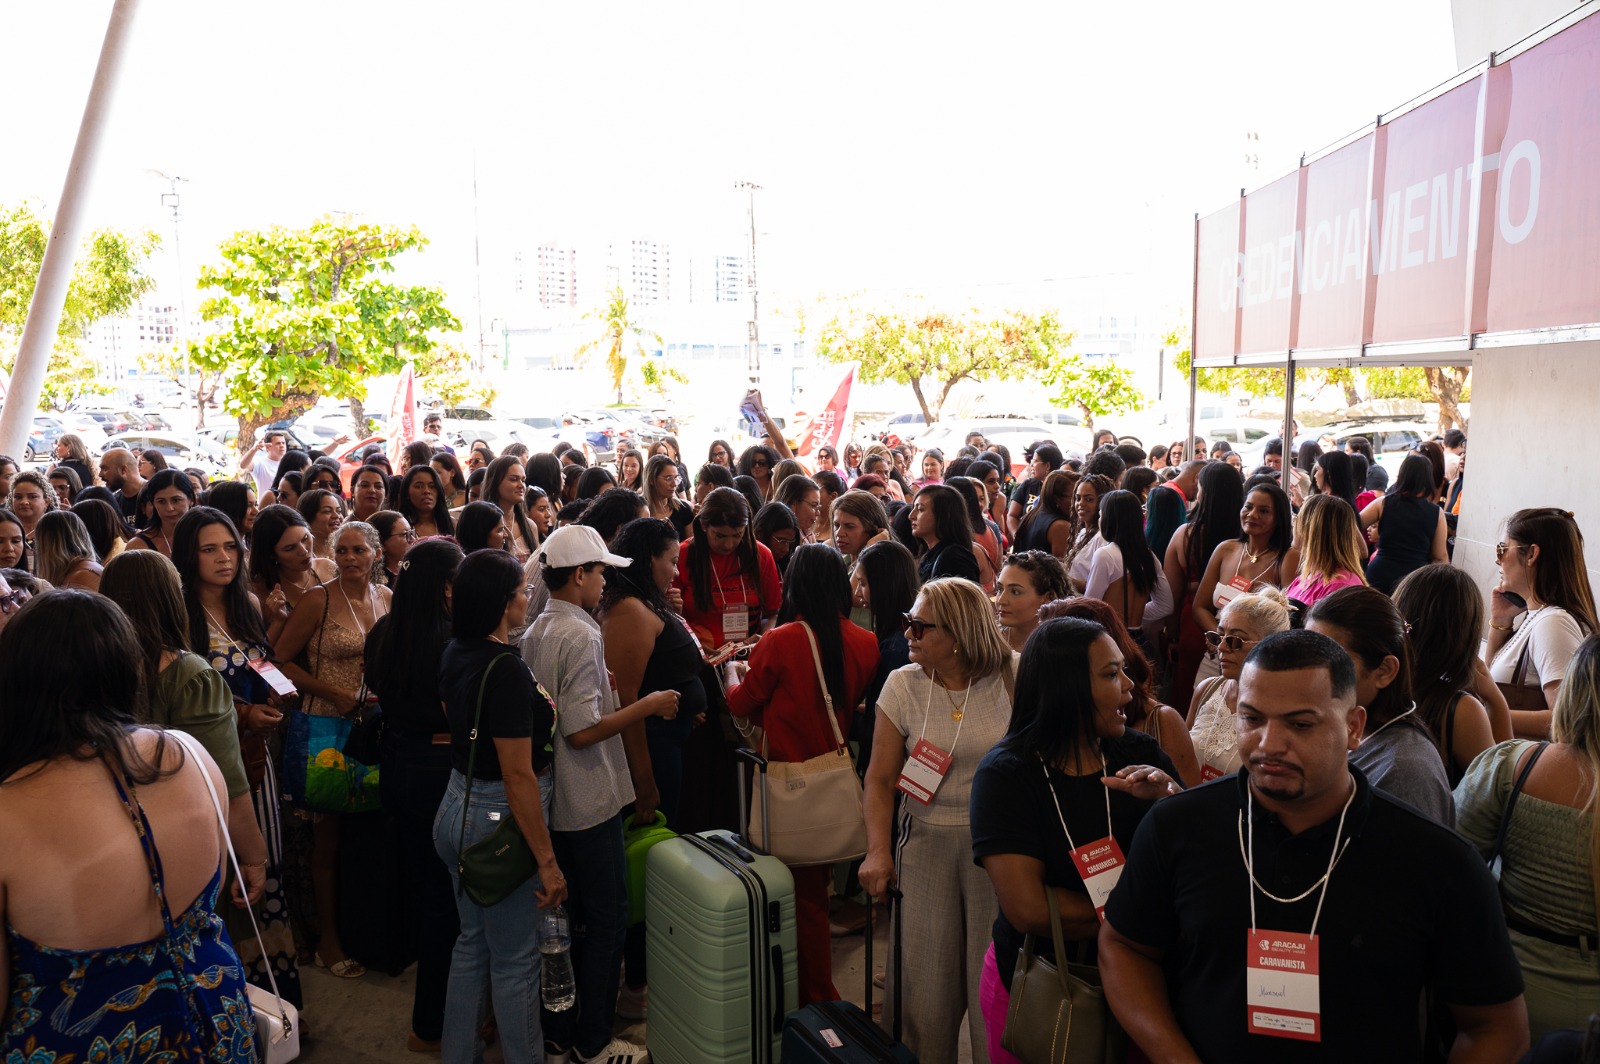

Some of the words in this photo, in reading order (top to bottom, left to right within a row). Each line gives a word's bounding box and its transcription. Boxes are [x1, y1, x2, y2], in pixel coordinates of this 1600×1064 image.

[1218, 139, 1542, 313] CREDENCIAMENTO
[811, 410, 827, 449] CAJU
[1089, 844, 1111, 857] ARACAJU
[1086, 857, 1118, 874] CARAVANISTA
[1271, 940, 1306, 950] ARACAJU
[1259, 956, 1306, 970] CARAVANISTA
